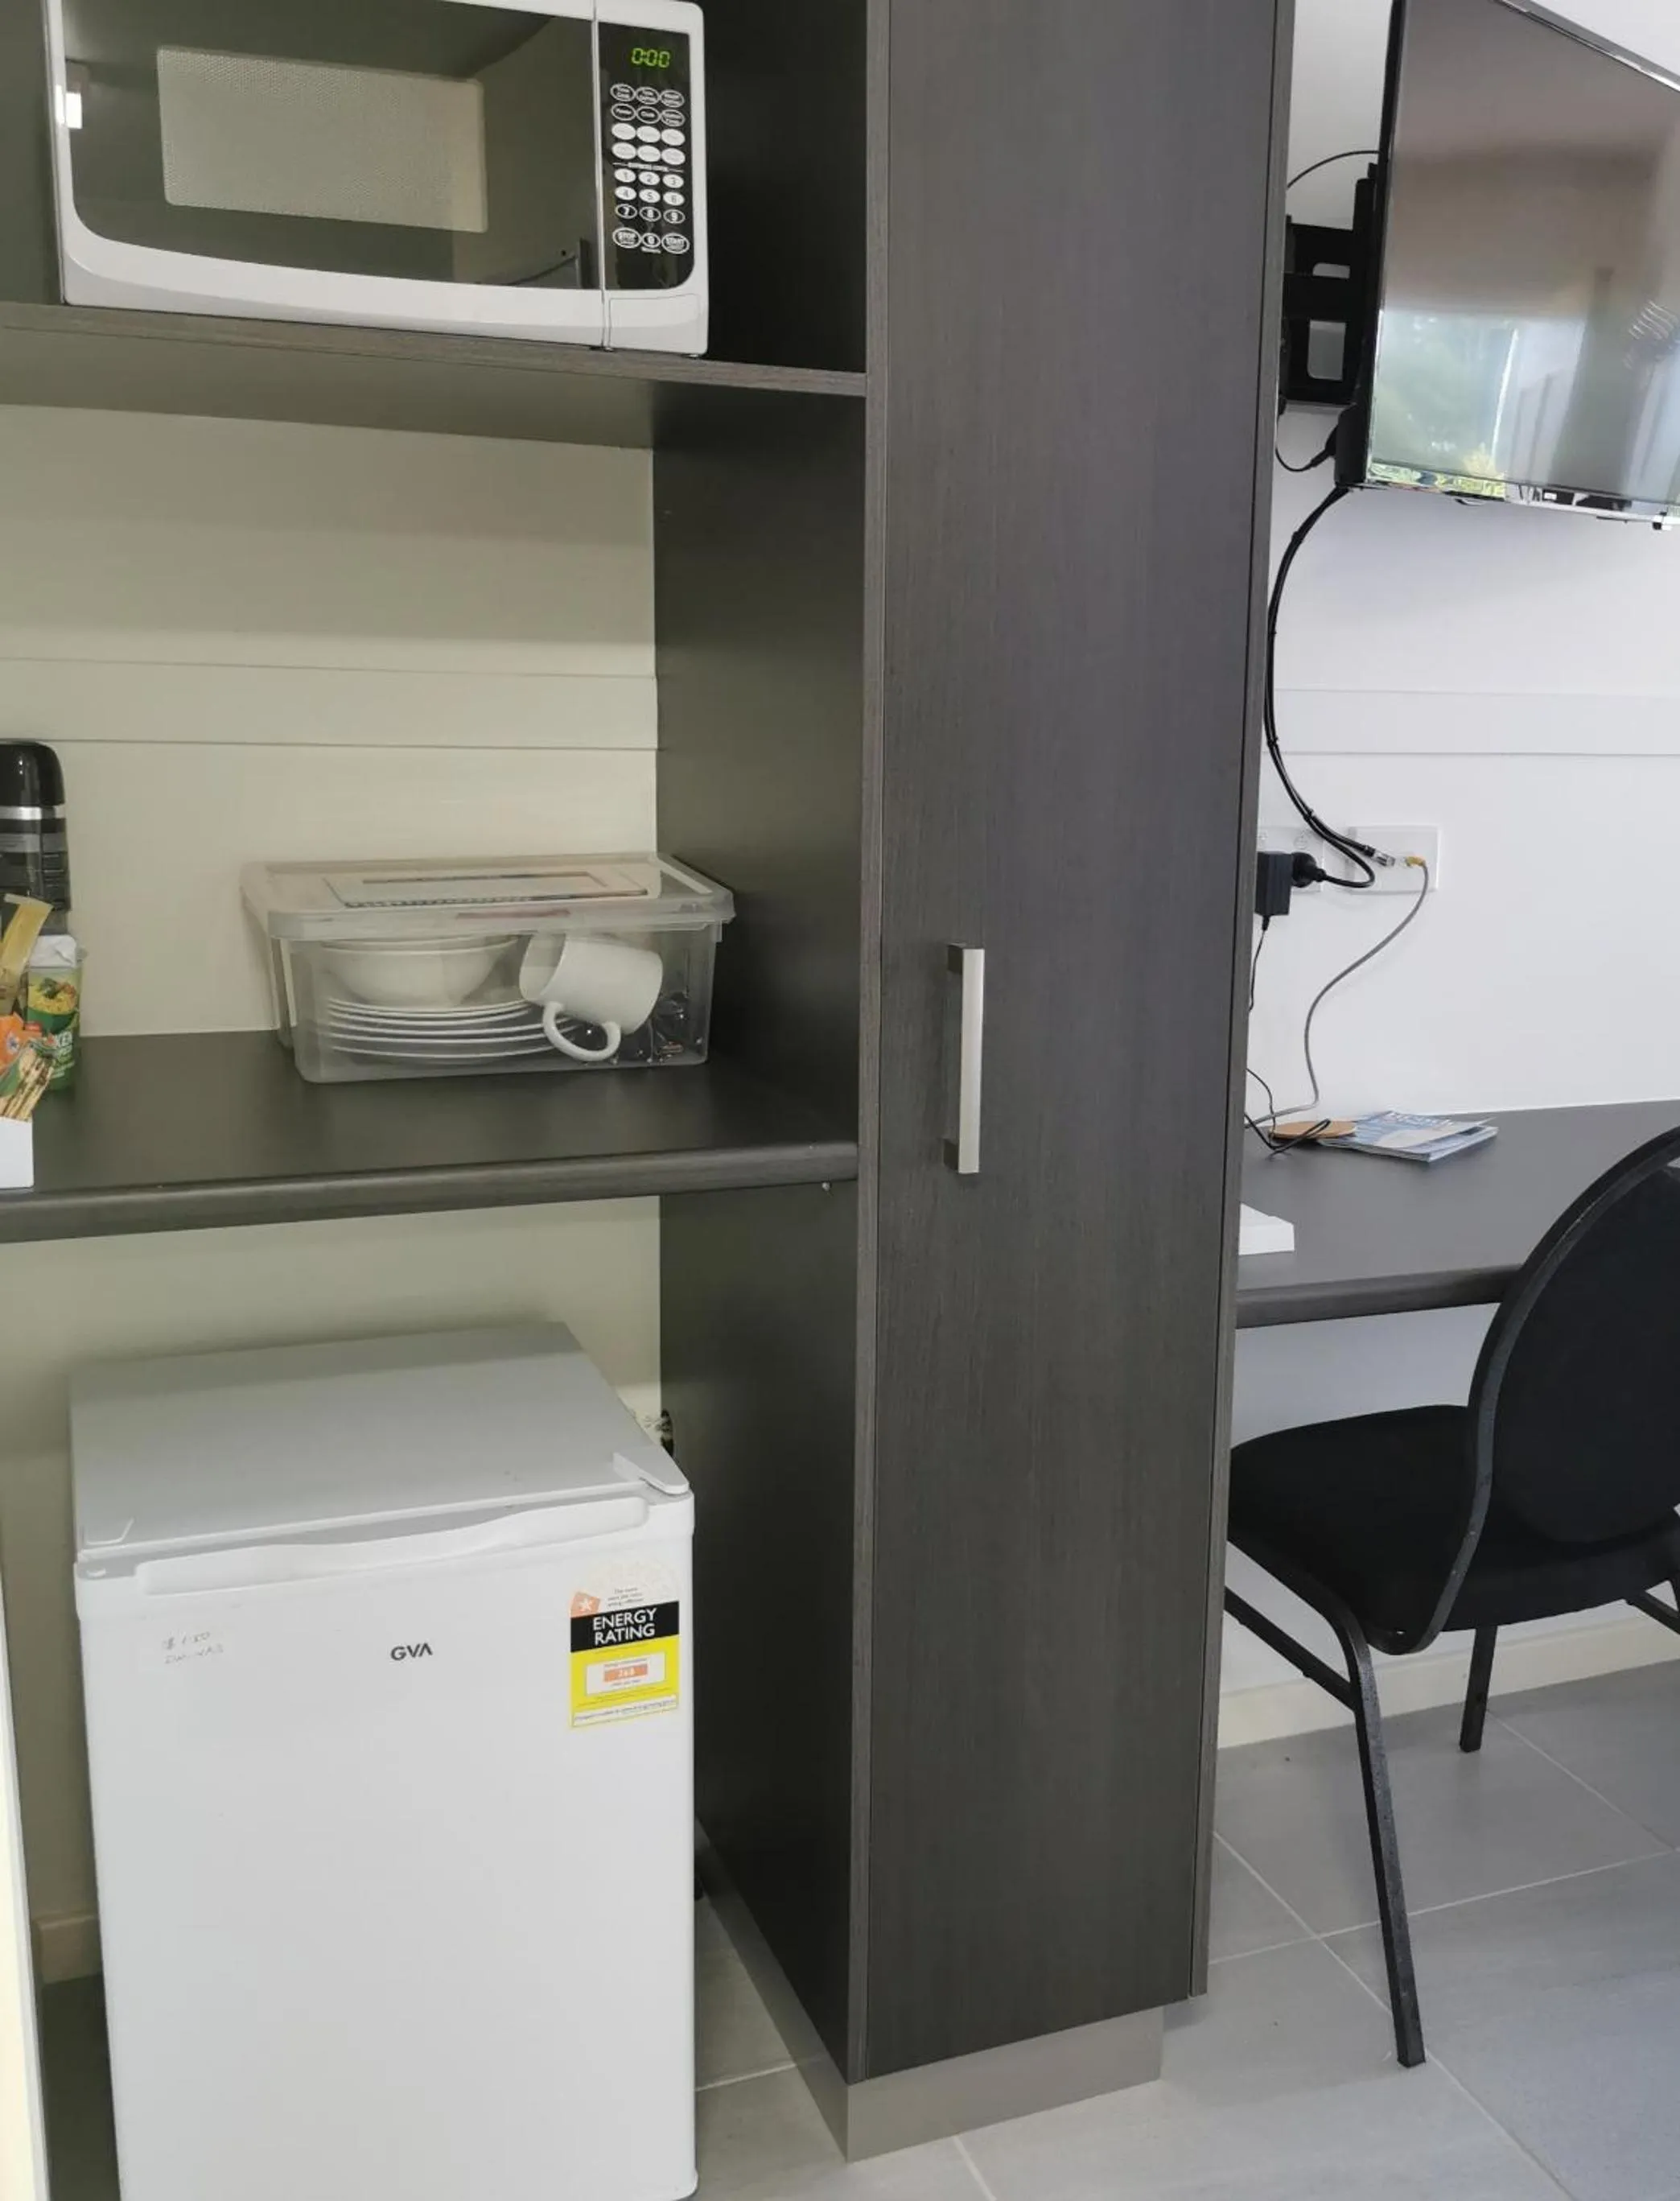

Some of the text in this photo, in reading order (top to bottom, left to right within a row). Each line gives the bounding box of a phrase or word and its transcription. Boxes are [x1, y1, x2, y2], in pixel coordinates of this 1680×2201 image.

[631, 47, 670, 68] 0:00
[593, 1607, 657, 1631] ENERGY
[595, 1623, 656, 1646] RATING
[390, 1643, 434, 1661] GVA
